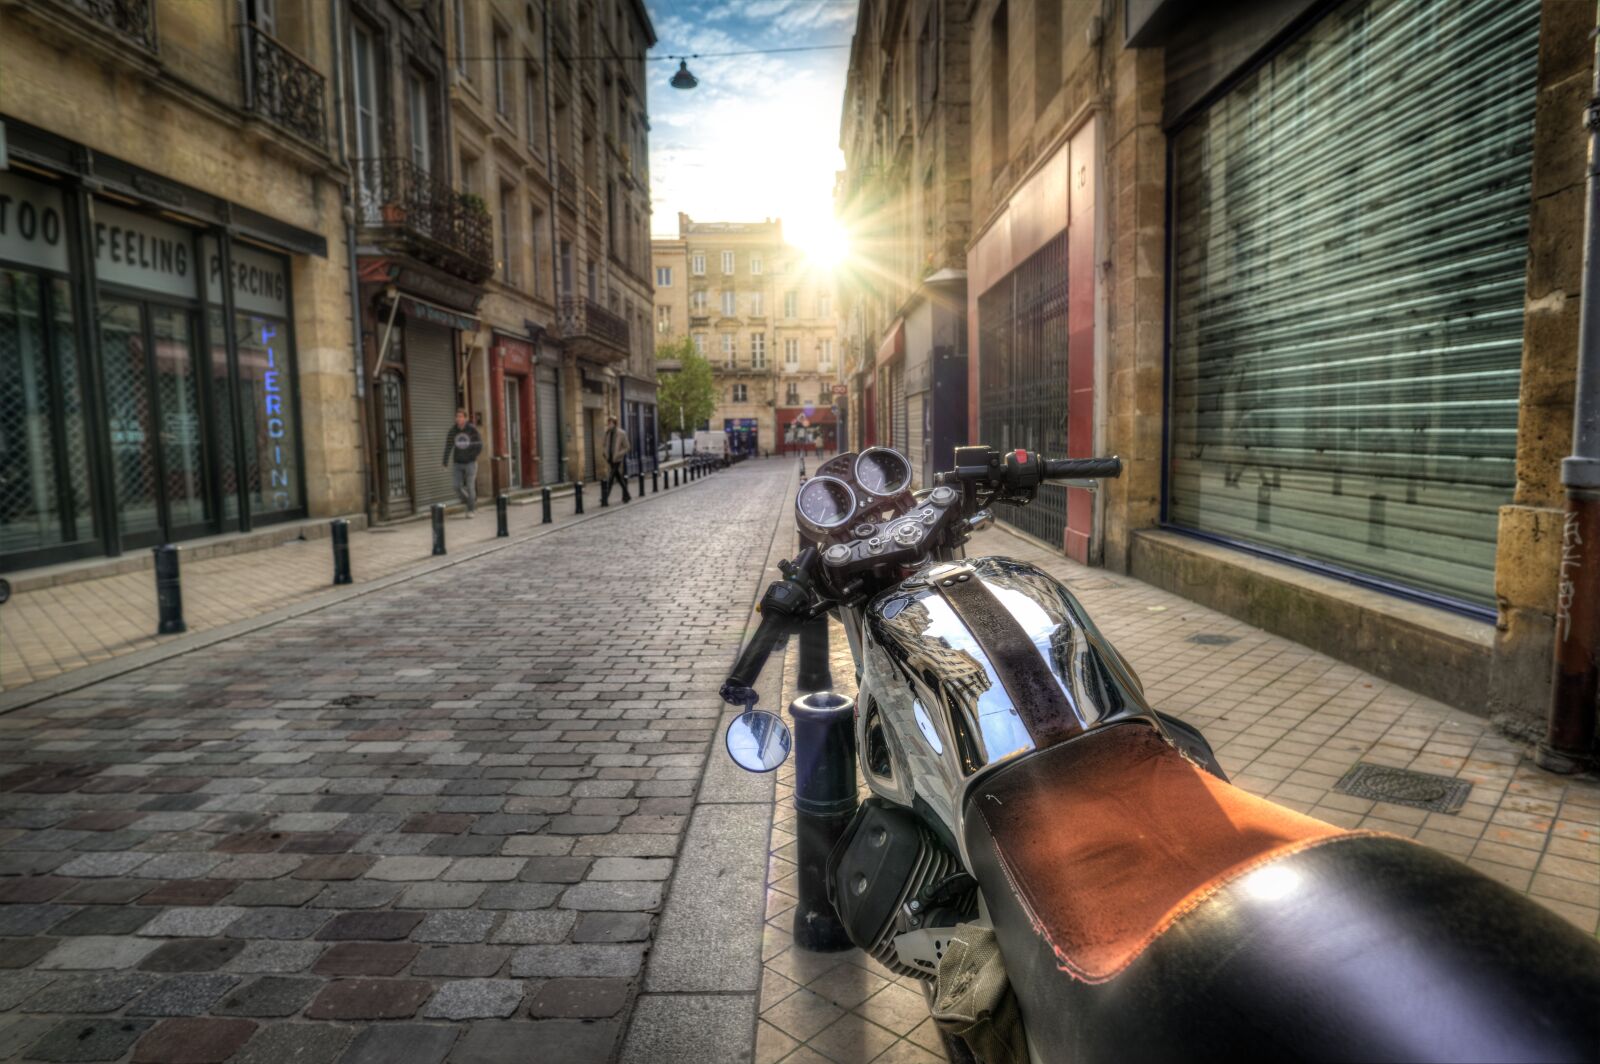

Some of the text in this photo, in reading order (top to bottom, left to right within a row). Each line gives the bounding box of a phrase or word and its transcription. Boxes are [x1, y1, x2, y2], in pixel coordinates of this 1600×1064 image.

[95, 222, 188, 277] FEELING
[209, 253, 283, 301] PERCING
[261, 321, 288, 511] PIERCING
